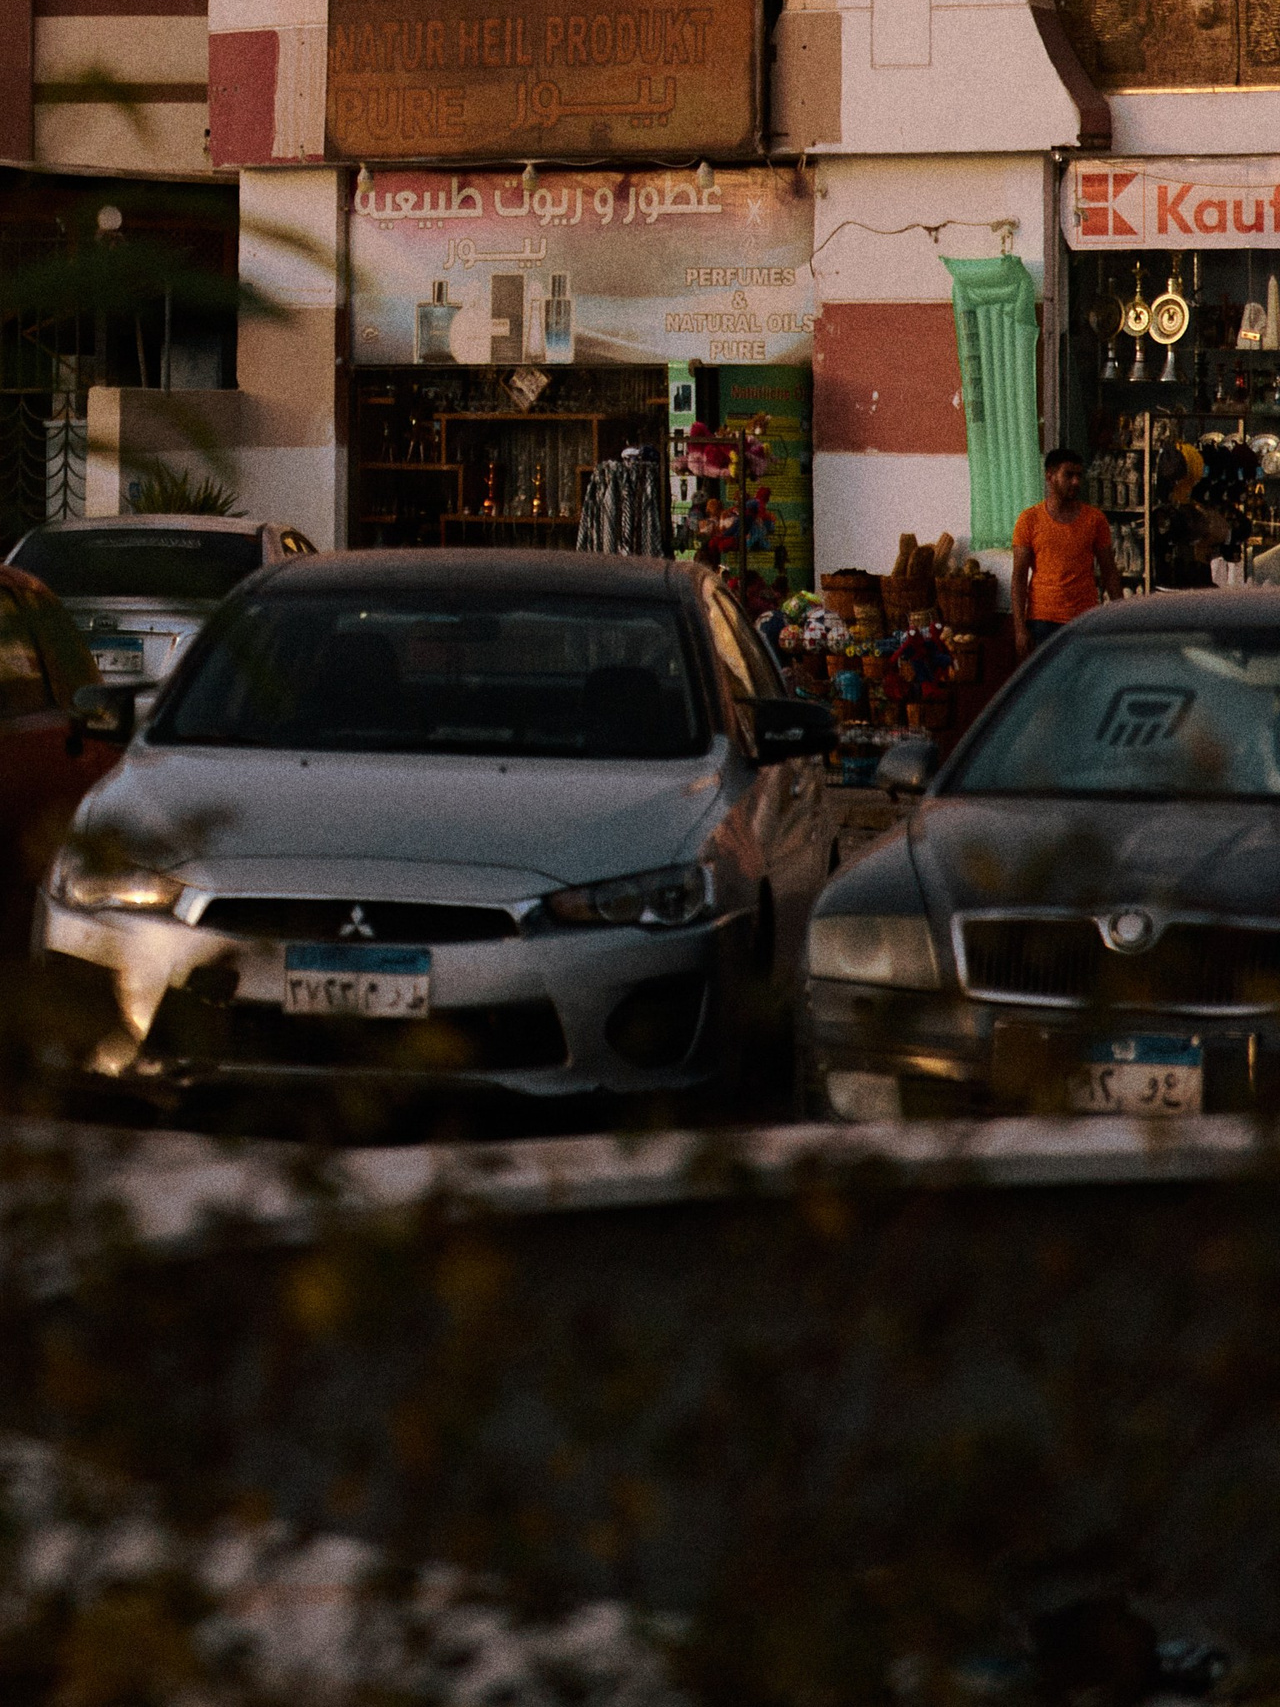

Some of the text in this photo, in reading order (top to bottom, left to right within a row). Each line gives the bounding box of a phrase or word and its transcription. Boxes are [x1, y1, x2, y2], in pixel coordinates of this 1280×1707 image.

[332, 8, 713, 71] NATUR HEIL PRODUKT
[335, 86, 467, 140] PURE
[508, 76, 677, 129] بيور
[593, 186, 614, 225] و
[622, 171, 722, 225] عطور
[443, 237, 547, 270] بيور
[685, 267, 796, 287] PERFUMES
[731, 290, 749, 311] &
[665, 313, 815, 334] NATURAL OILS
[708, 340, 766, 361] PURE
